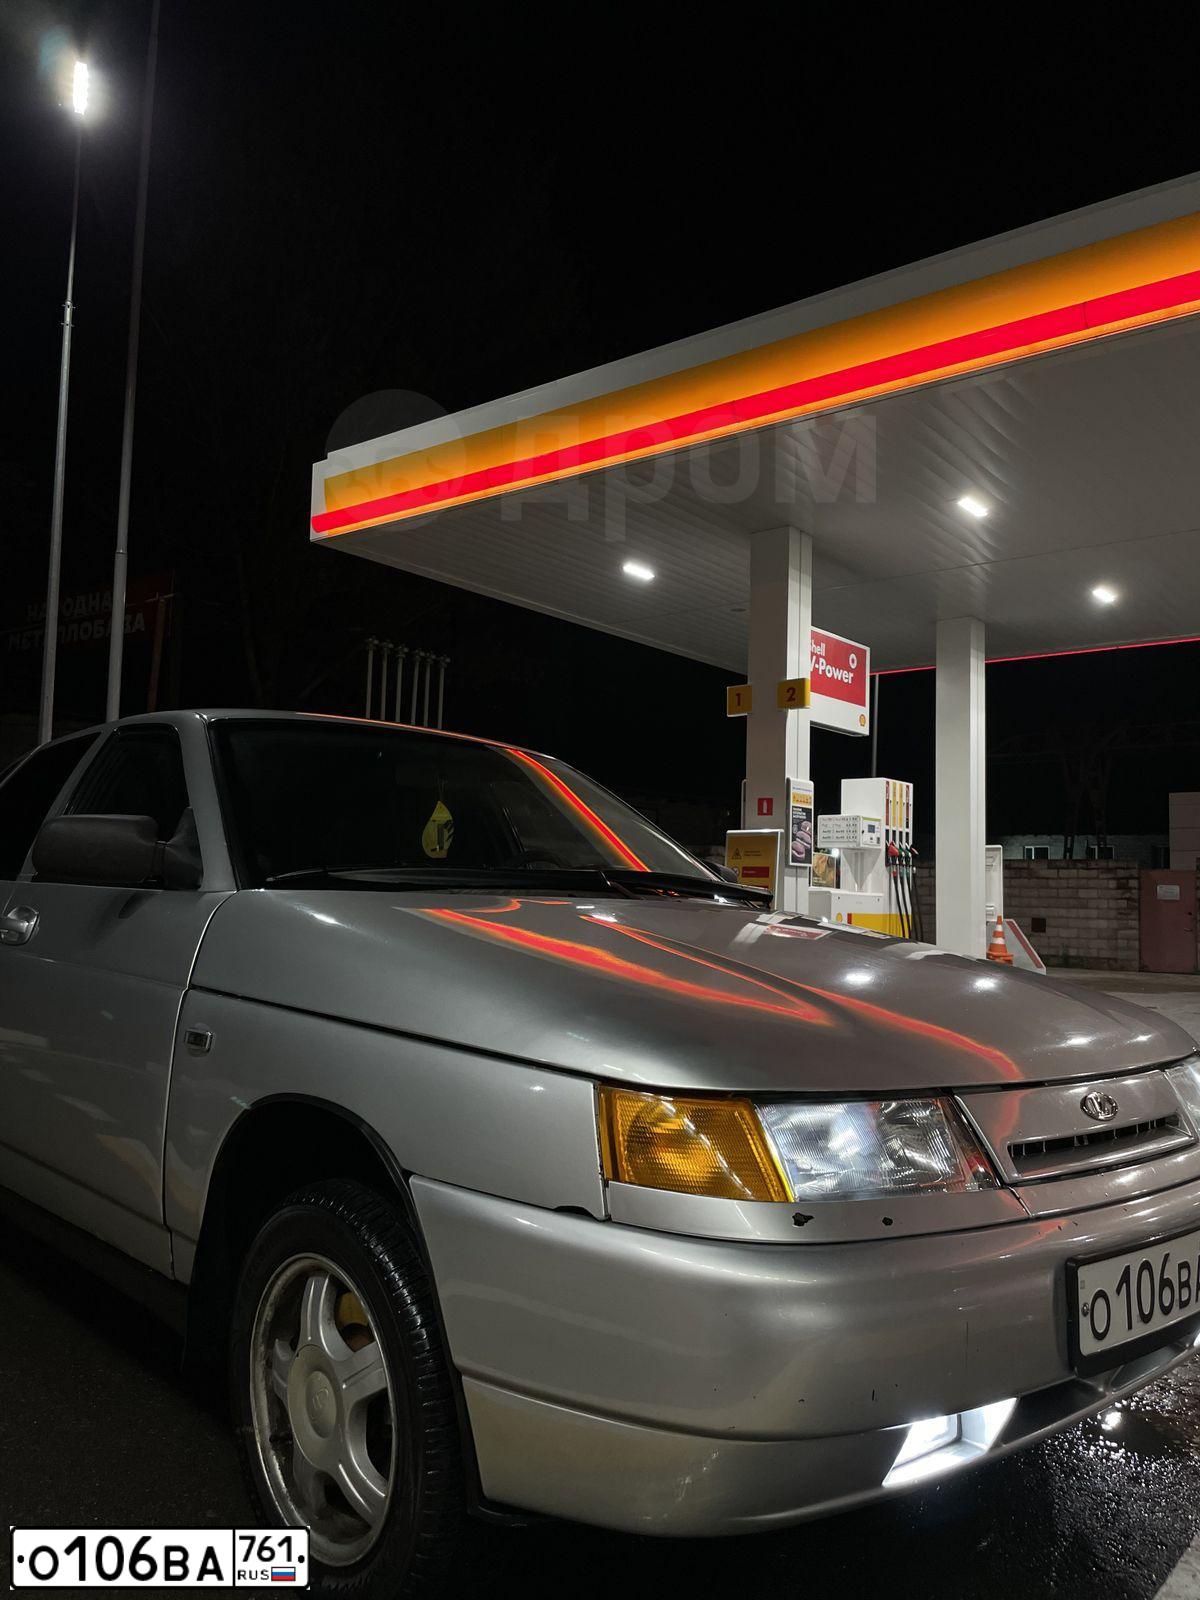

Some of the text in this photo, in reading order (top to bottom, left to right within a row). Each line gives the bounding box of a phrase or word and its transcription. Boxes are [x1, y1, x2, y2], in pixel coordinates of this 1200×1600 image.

[810, 638, 826, 657] hell
[735, 692, 742, 707] 1
[785, 686, 797, 703] 2
